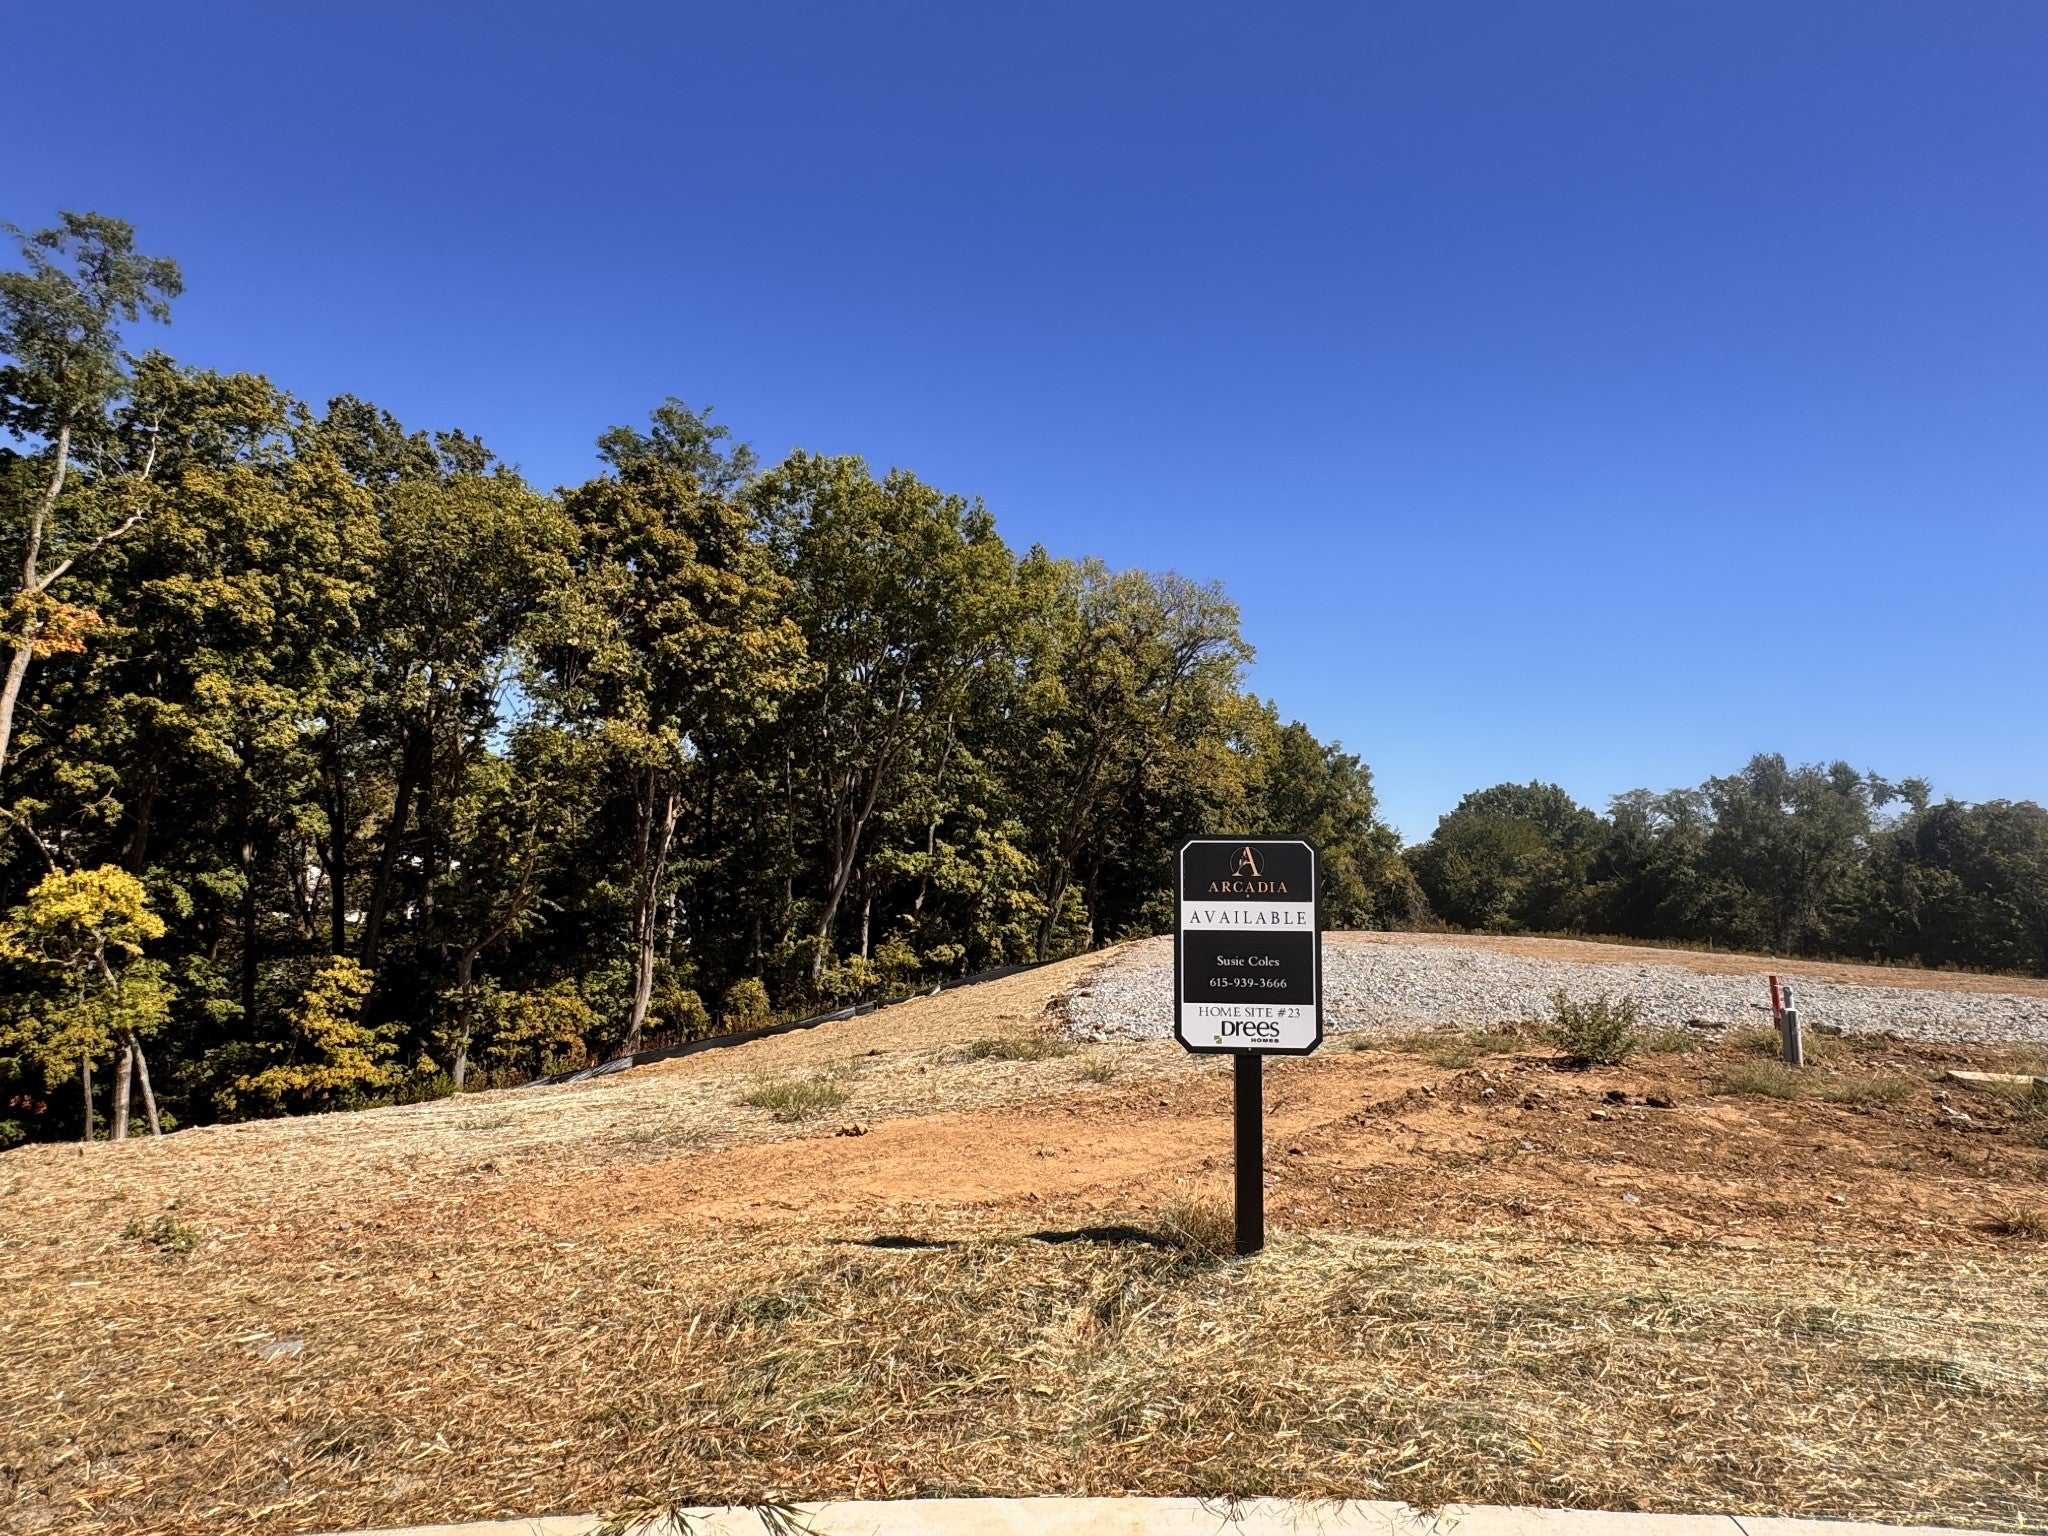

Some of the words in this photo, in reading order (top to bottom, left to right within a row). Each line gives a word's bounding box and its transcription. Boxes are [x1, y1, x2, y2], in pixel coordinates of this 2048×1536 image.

[1232, 846, 1262, 877] A
[1208, 881, 1288, 893] ARCADIA
[1190, 910, 1307, 925] AVAILABLE
[1217, 955, 1245, 967] Susie
[1248, 956, 1280, 967] Coles
[1210, 978, 1287, 989] 615-939-3666
[1198, 1006, 1241, 1017] HOME
[1244, 1007, 1273, 1018] SITE
[1277, 1008, 1301, 1018] #23
[1221, 1020, 1280, 1037] Drees
